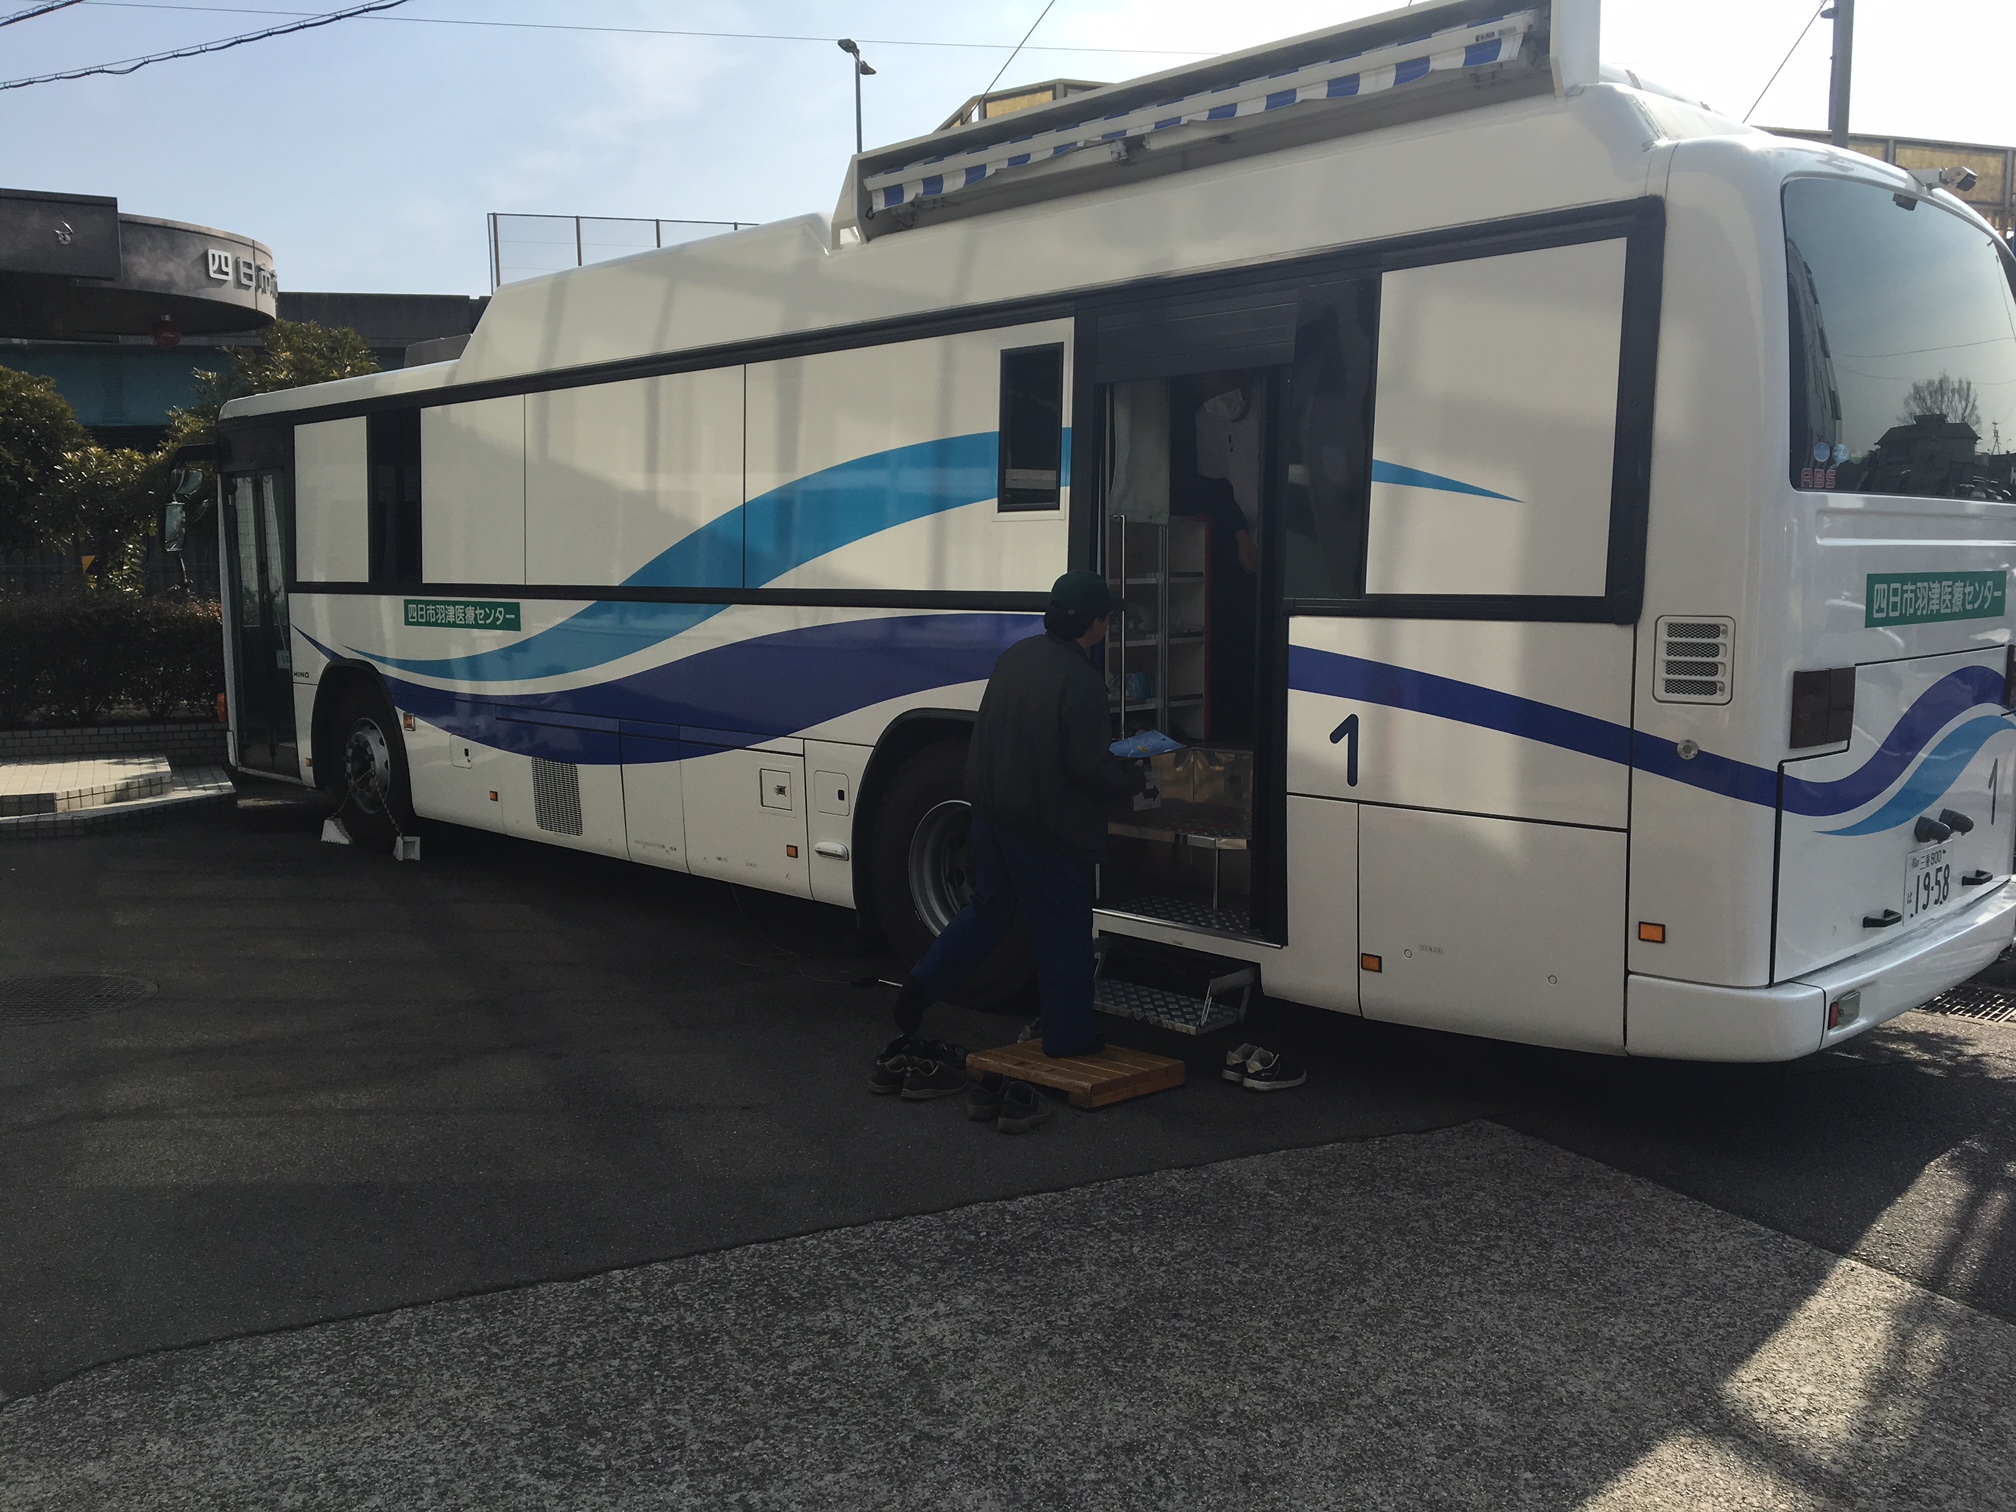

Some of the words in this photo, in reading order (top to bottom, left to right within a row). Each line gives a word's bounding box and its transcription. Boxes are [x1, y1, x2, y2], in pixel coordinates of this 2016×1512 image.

[208, 248, 278, 298] 四日市
[1801, 467, 1836, 489] ABS
[407, 604, 515, 626] 四日市羽津医療センター
[1873, 580, 2002, 618] 四日市羽津医療センター
[293, 671, 310, 679] HINO
[1329, 713, 1359, 787] 1
[1988, 758, 1999, 826] 1
[1915, 863, 1951, 915] 19-58
